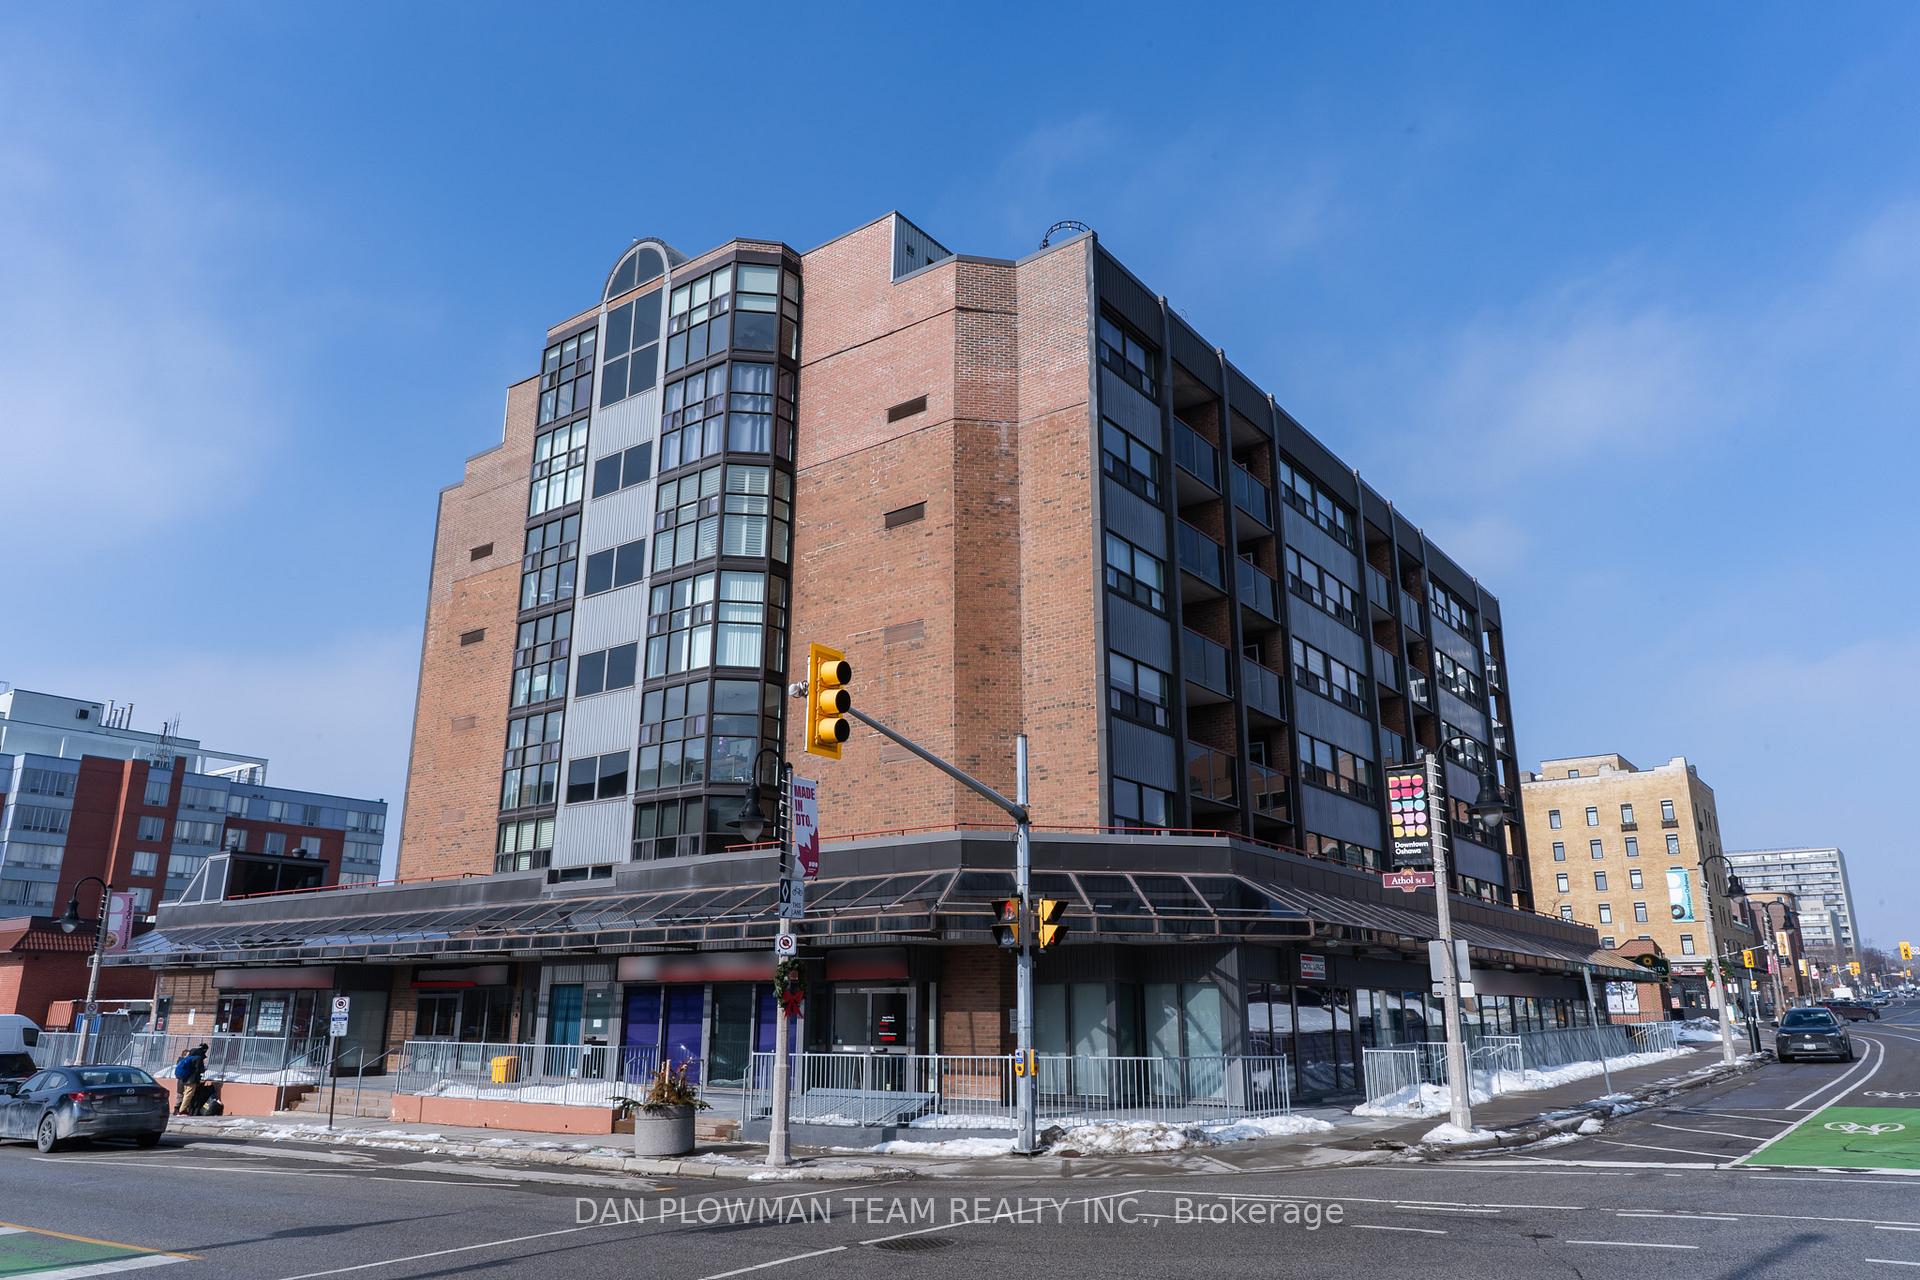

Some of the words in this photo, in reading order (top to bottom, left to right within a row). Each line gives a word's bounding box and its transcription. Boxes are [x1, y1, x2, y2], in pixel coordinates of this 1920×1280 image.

[794, 785, 815, 800] MADE
[795, 800, 803, 812] IN
[796, 814, 813, 827] DTO.
[1395, 841, 1428, 849] Downtown
[1392, 875, 1413, 885] Athol
